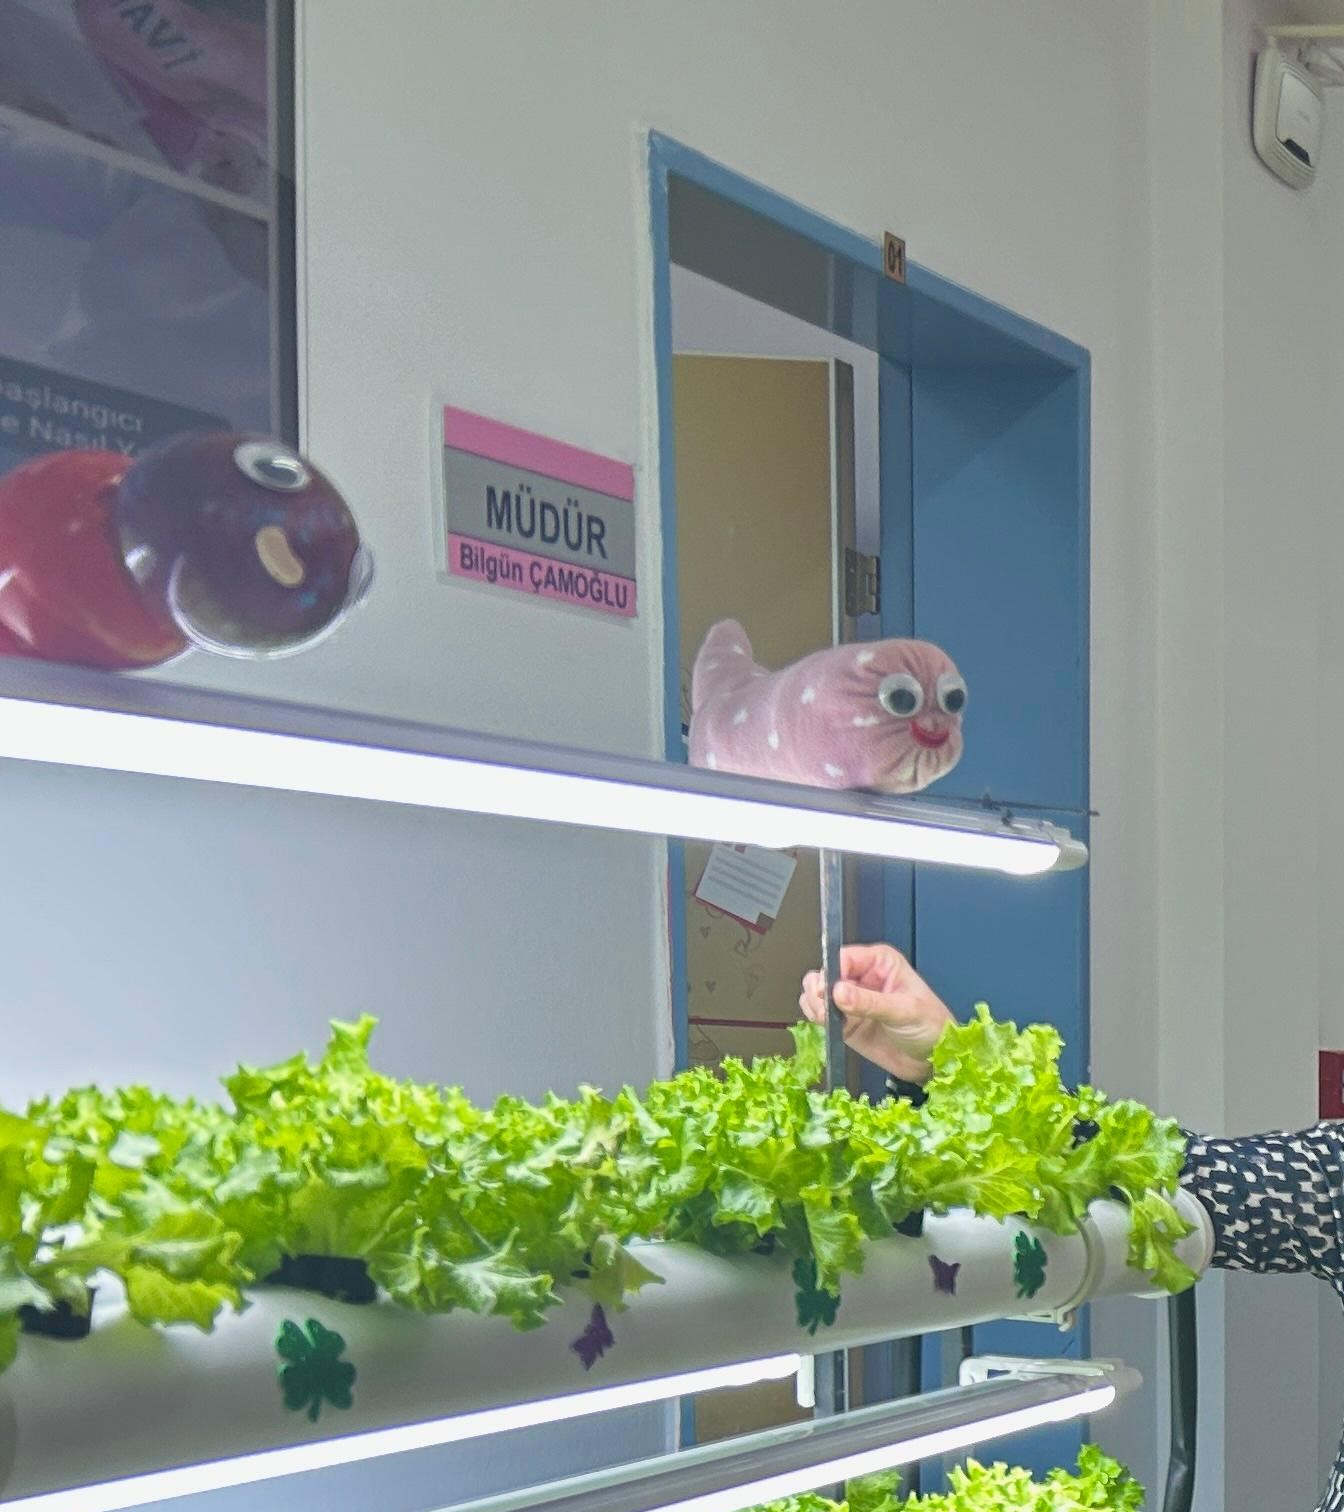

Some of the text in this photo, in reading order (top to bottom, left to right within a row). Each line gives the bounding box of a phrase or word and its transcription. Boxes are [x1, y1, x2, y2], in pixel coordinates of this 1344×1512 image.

[0, 382, 141, 434] aşlangıcı
[486, 483, 608, 560] MÜDÜR
[460, 542, 627, 609] Bilgün ÇAMOĞLU
